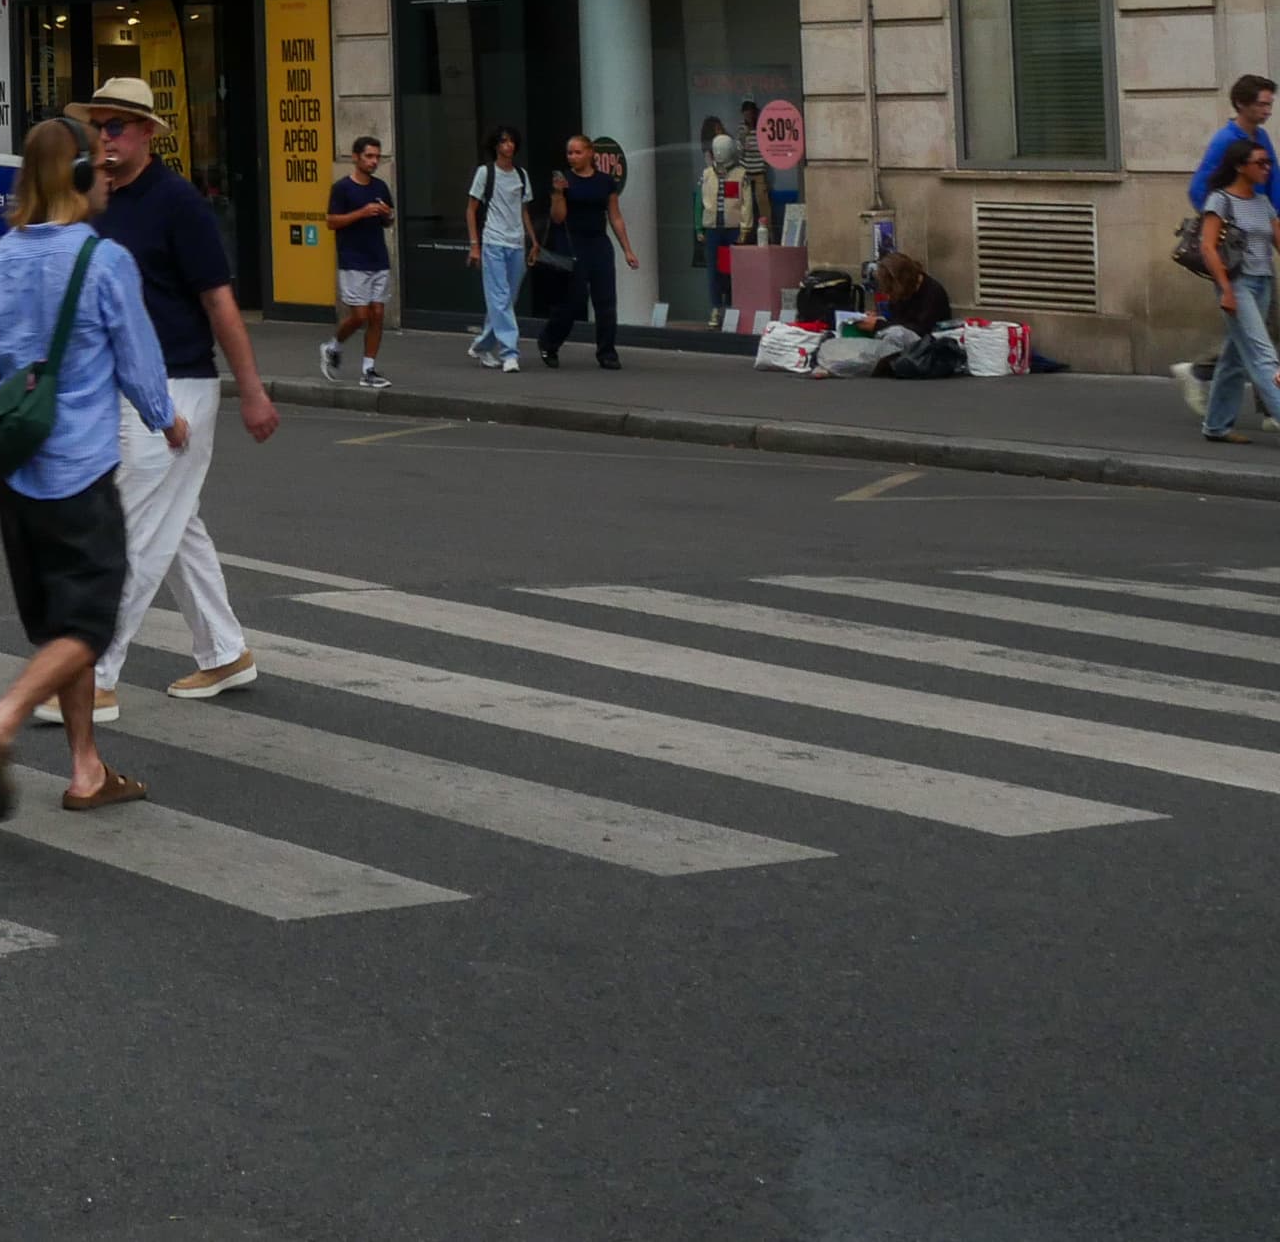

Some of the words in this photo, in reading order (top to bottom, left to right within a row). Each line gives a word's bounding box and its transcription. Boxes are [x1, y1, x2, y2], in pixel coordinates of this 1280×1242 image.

[282, 38, 315, 63] MATIN
[287, 69, 312, 92] MIDI
[279, 94, 320, 123] GOÛTER
[283, 124, 318, 153] APÉRO
[761, 117, 800, 141] -30%
[286, 154, 318, 183] DÎNER
